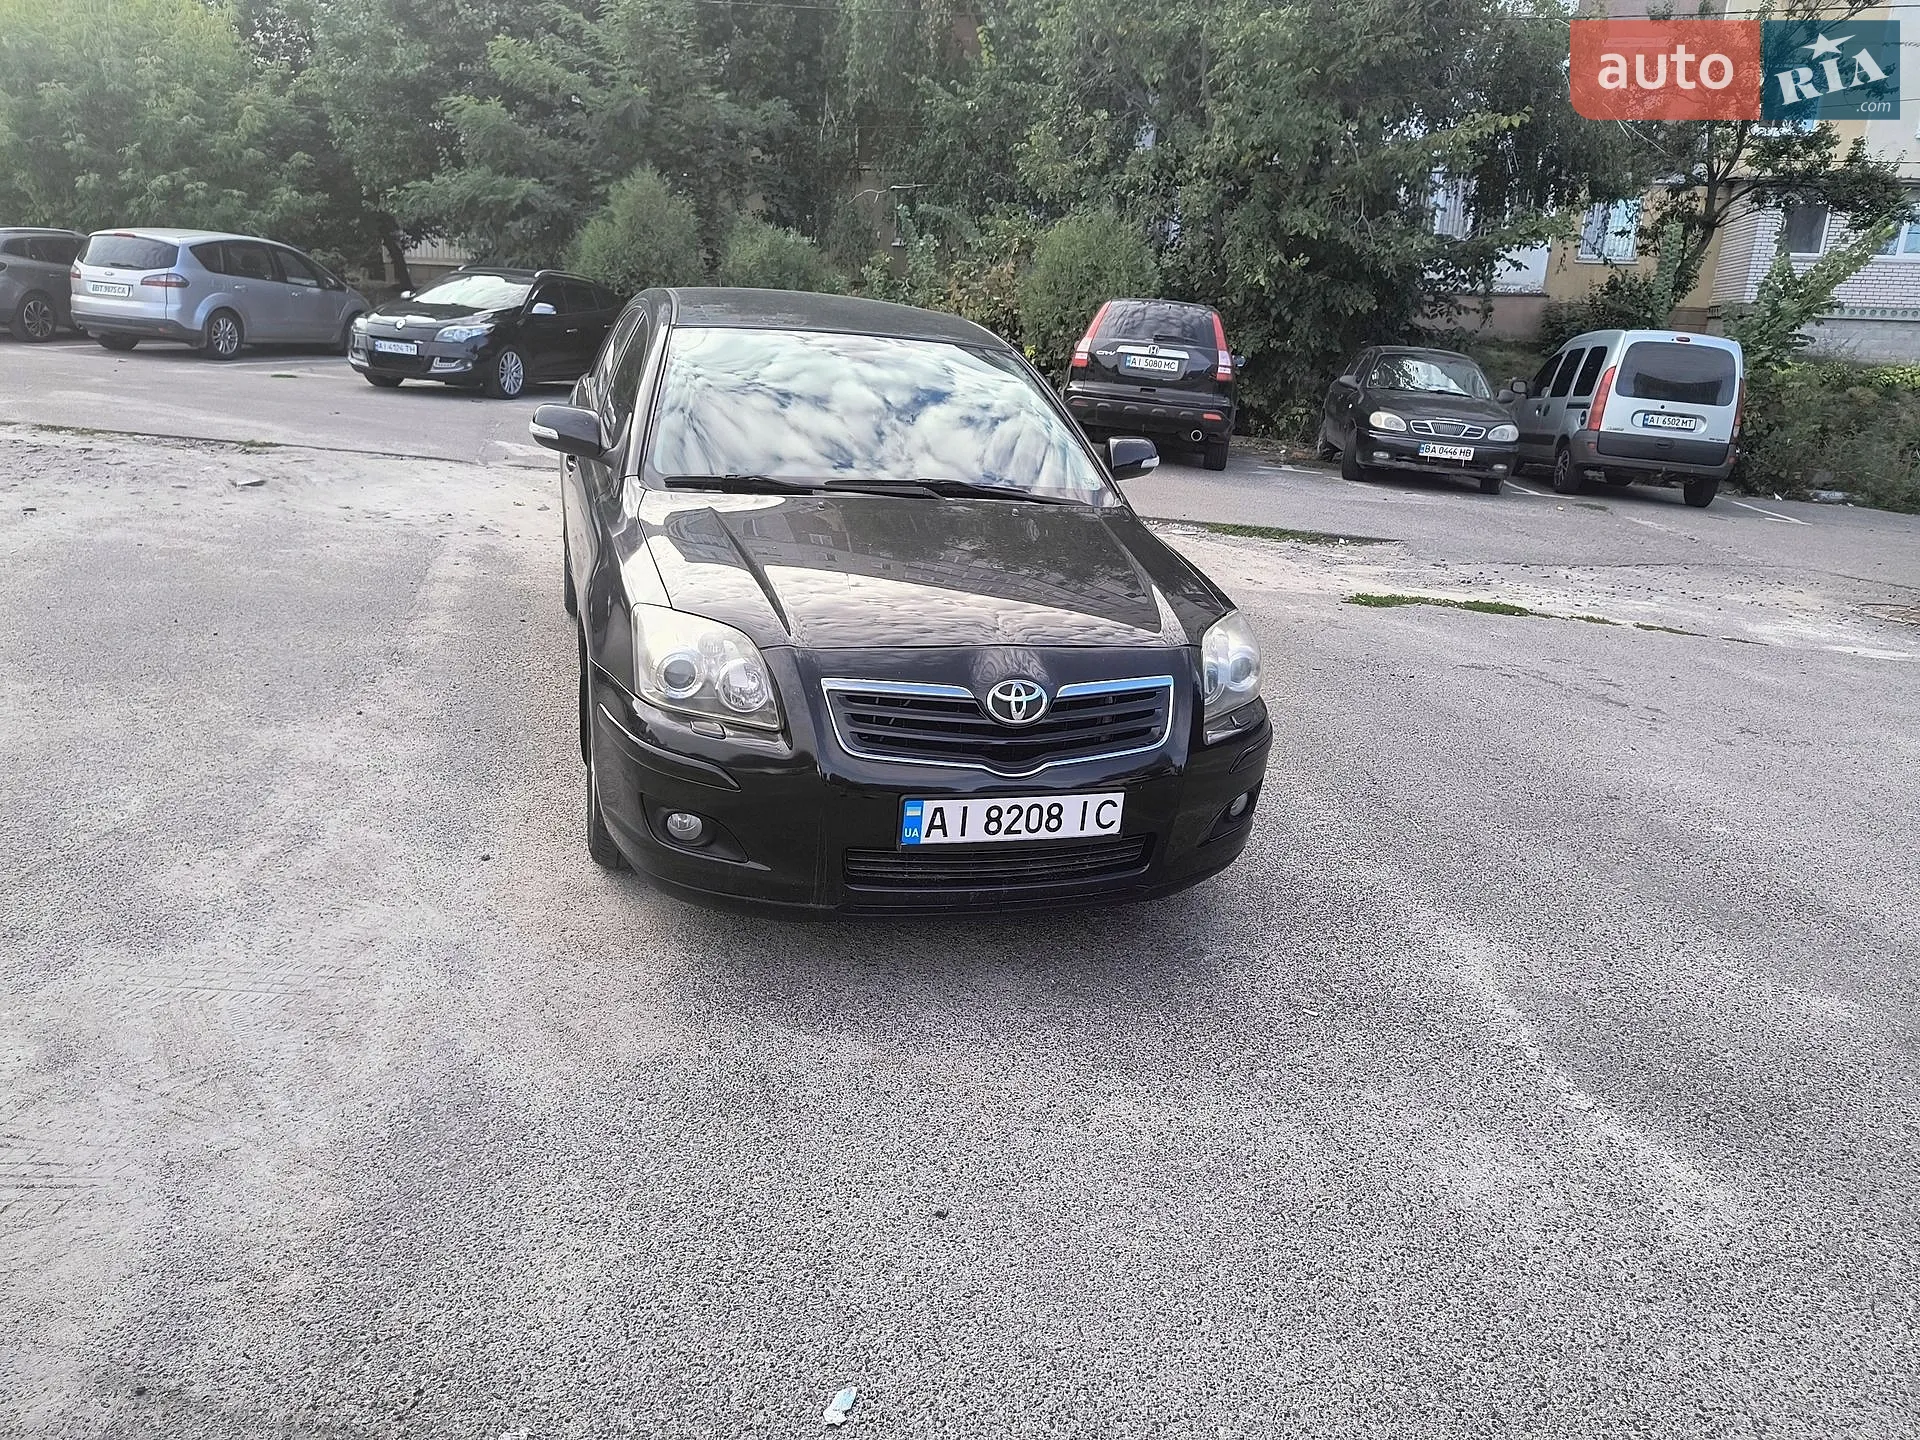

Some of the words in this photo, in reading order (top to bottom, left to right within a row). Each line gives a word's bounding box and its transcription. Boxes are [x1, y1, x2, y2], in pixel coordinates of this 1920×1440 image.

[1130, 357, 1142, 367] AI
[1144, 358, 1163, 369] 5080
[1163, 361, 1176, 370] MC
[1649, 416, 1660, 424] AI
[1661, 417, 1681, 427] 6502
[1681, 419, 1694, 428] MT
[1424, 444, 1437, 454] BA
[1438, 446, 1458, 457] 0446
[1459, 448, 1472, 458] HB
[924, 805, 969, 839] AI
[983, 802, 1064, 836] 8208
[1079, 799, 1119, 832] IC
[904, 828, 920, 838] UA
